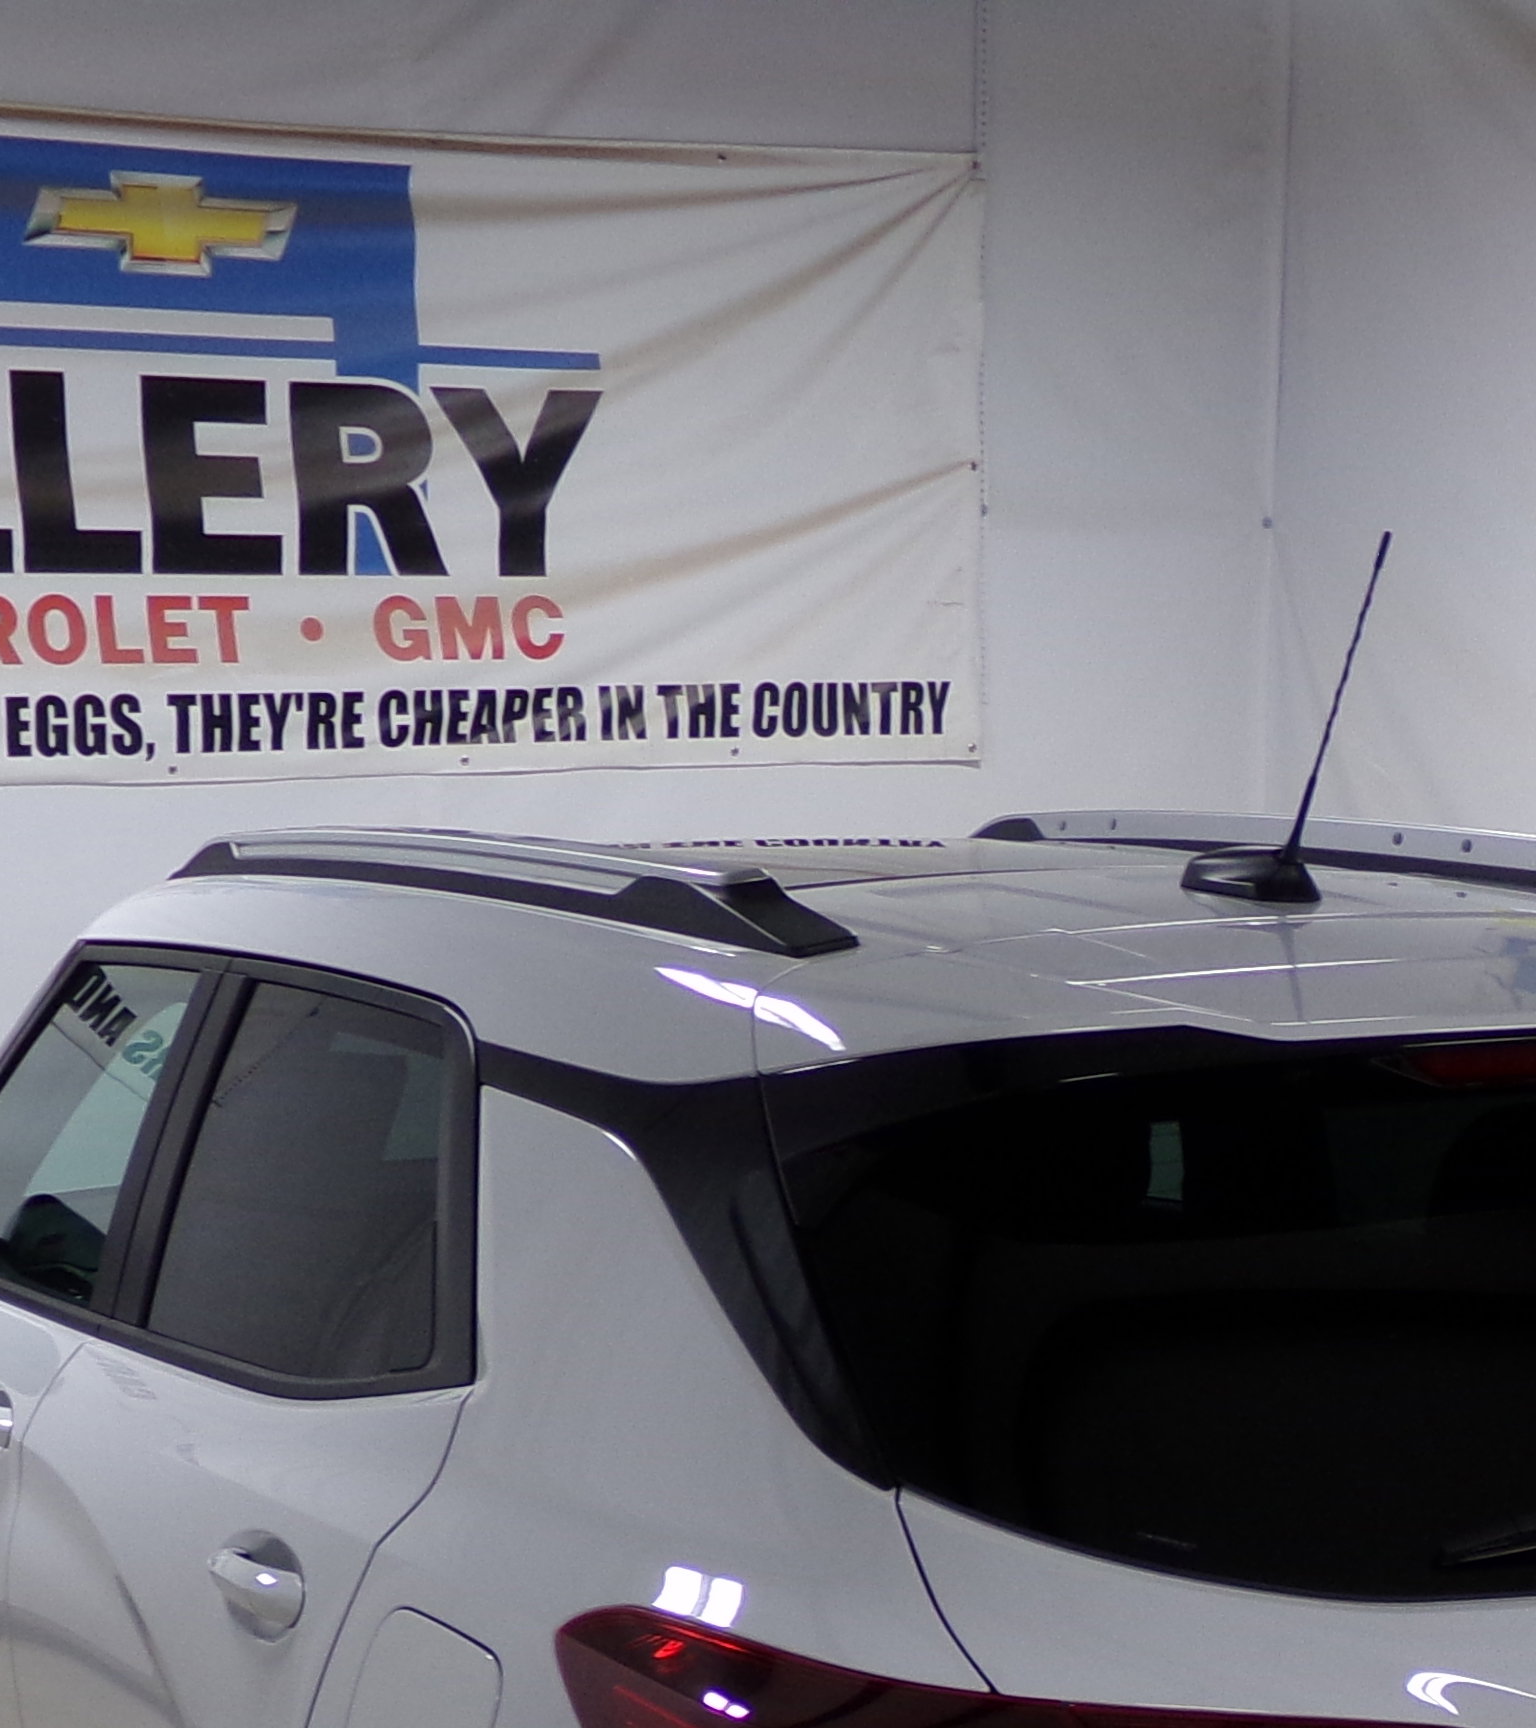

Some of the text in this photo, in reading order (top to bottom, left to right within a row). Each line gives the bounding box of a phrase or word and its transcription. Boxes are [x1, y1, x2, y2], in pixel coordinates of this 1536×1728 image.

[374, 594, 565, 662] GMC
[4, 692, 156, 761] EGGS,
[166, 688, 366, 755] THEY'RE
[377, 684, 586, 749] CHEAPER
[598, 684, 645, 742] IN
[656, 683, 741, 740] THE
[751, 680, 951, 739] COUNTRY
